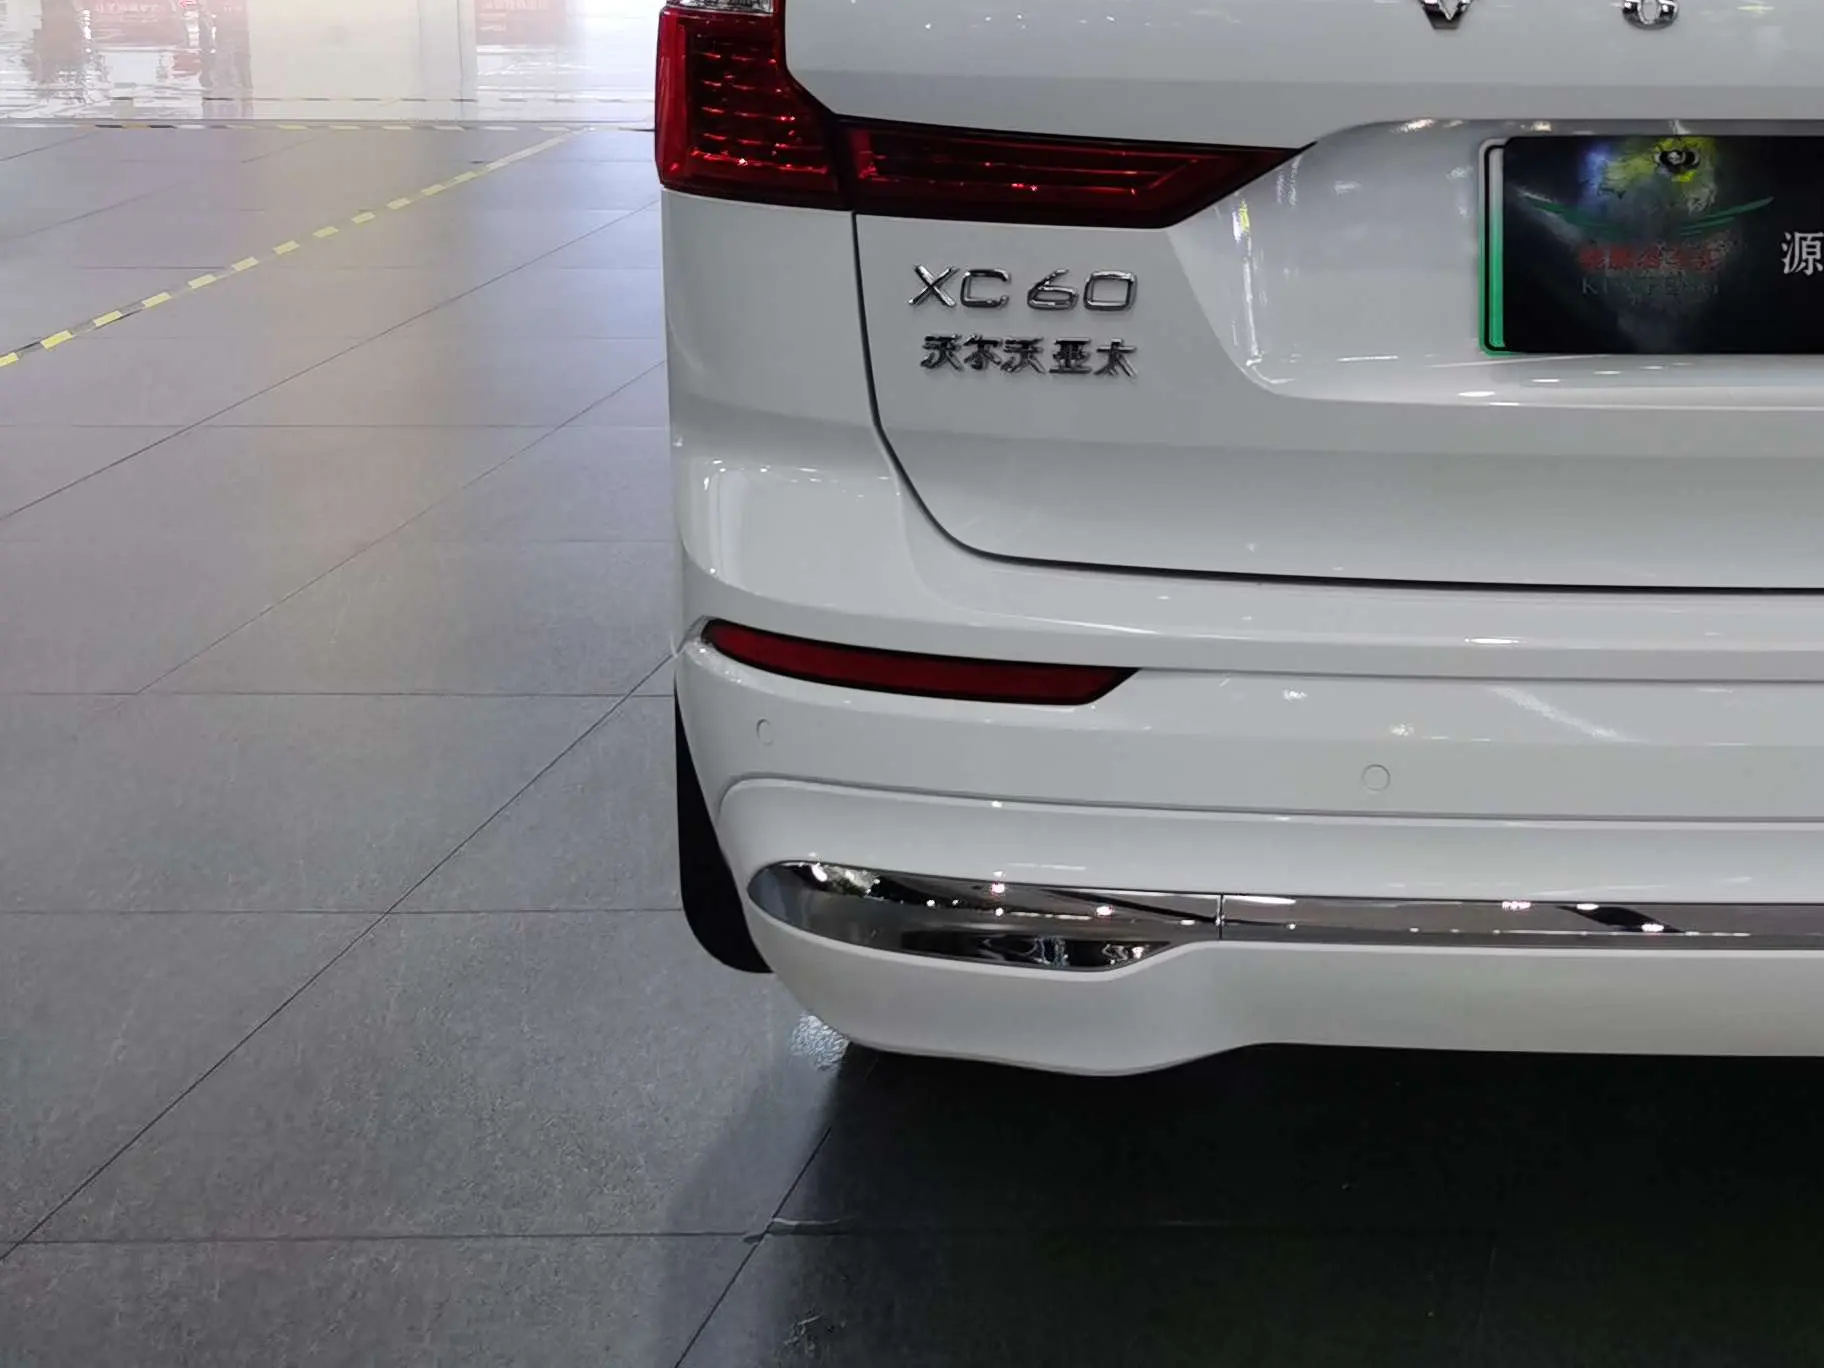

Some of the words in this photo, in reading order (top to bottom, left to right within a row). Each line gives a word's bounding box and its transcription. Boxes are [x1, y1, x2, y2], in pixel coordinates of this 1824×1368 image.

[920, 334, 1139, 378] 沃尔沃亚太
